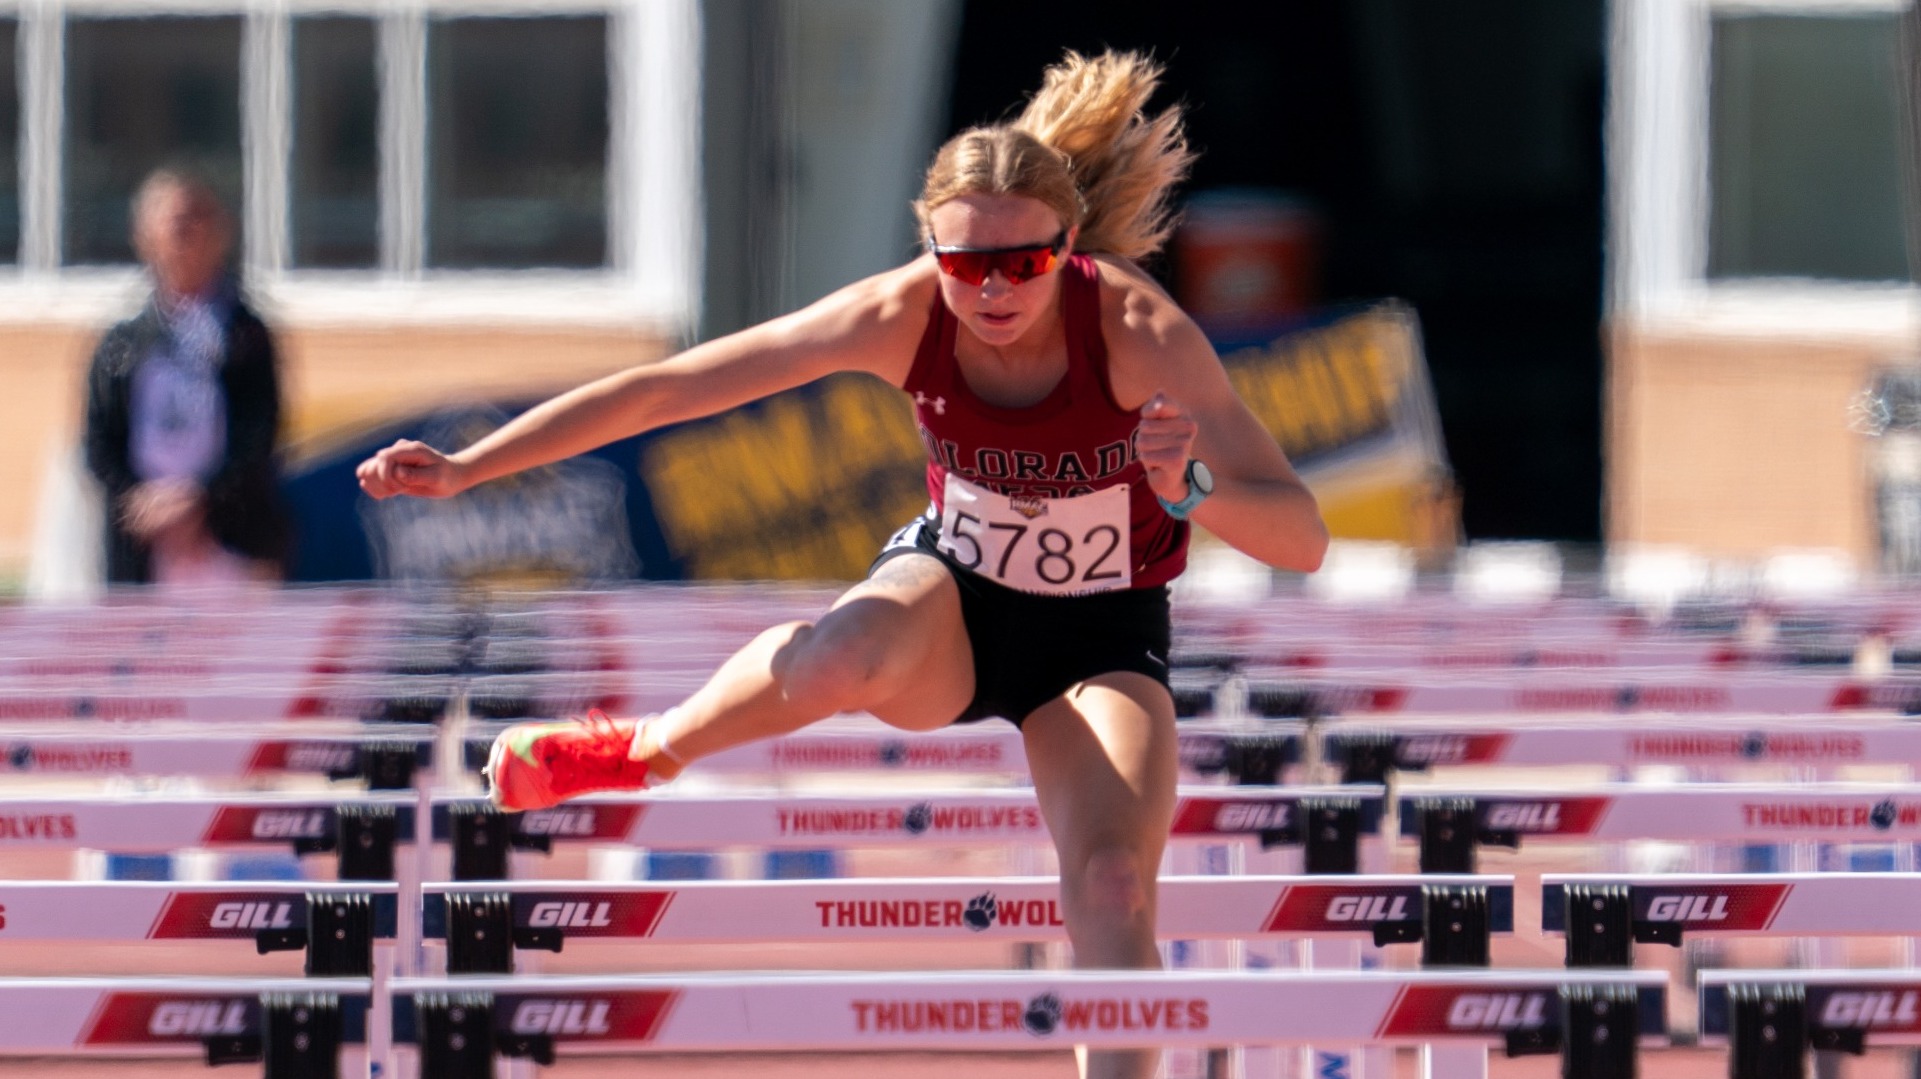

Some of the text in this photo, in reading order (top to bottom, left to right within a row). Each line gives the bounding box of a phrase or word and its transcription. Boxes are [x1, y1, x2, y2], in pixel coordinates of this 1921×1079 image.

[947, 510, 1122, 585] 5782
[251, 809, 326, 837] GILL
[519, 808, 596, 836] GILL
[776, 806, 1041, 832] THUNDER WOLVES
[1213, 803, 1291, 831] GILL
[1485, 802, 1562, 830] GILL
[1741, 803, 1869, 828] THUNDER
[209, 902, 293, 929] GILL
[528, 901, 613, 928] GILL
[815, 900, 1063, 928] THUNDER WOL
[1325, 896, 1408, 922] GILL
[1646, 895, 1729, 922] GILL
[148, 1001, 248, 1036] GILL
[512, 1000, 611, 1035] GILL
[851, 998, 1210, 1032] THUNDER WOLVES
[1447, 994, 1545, 1028] GILL
[1822, 991, 1918, 1026] GILL
